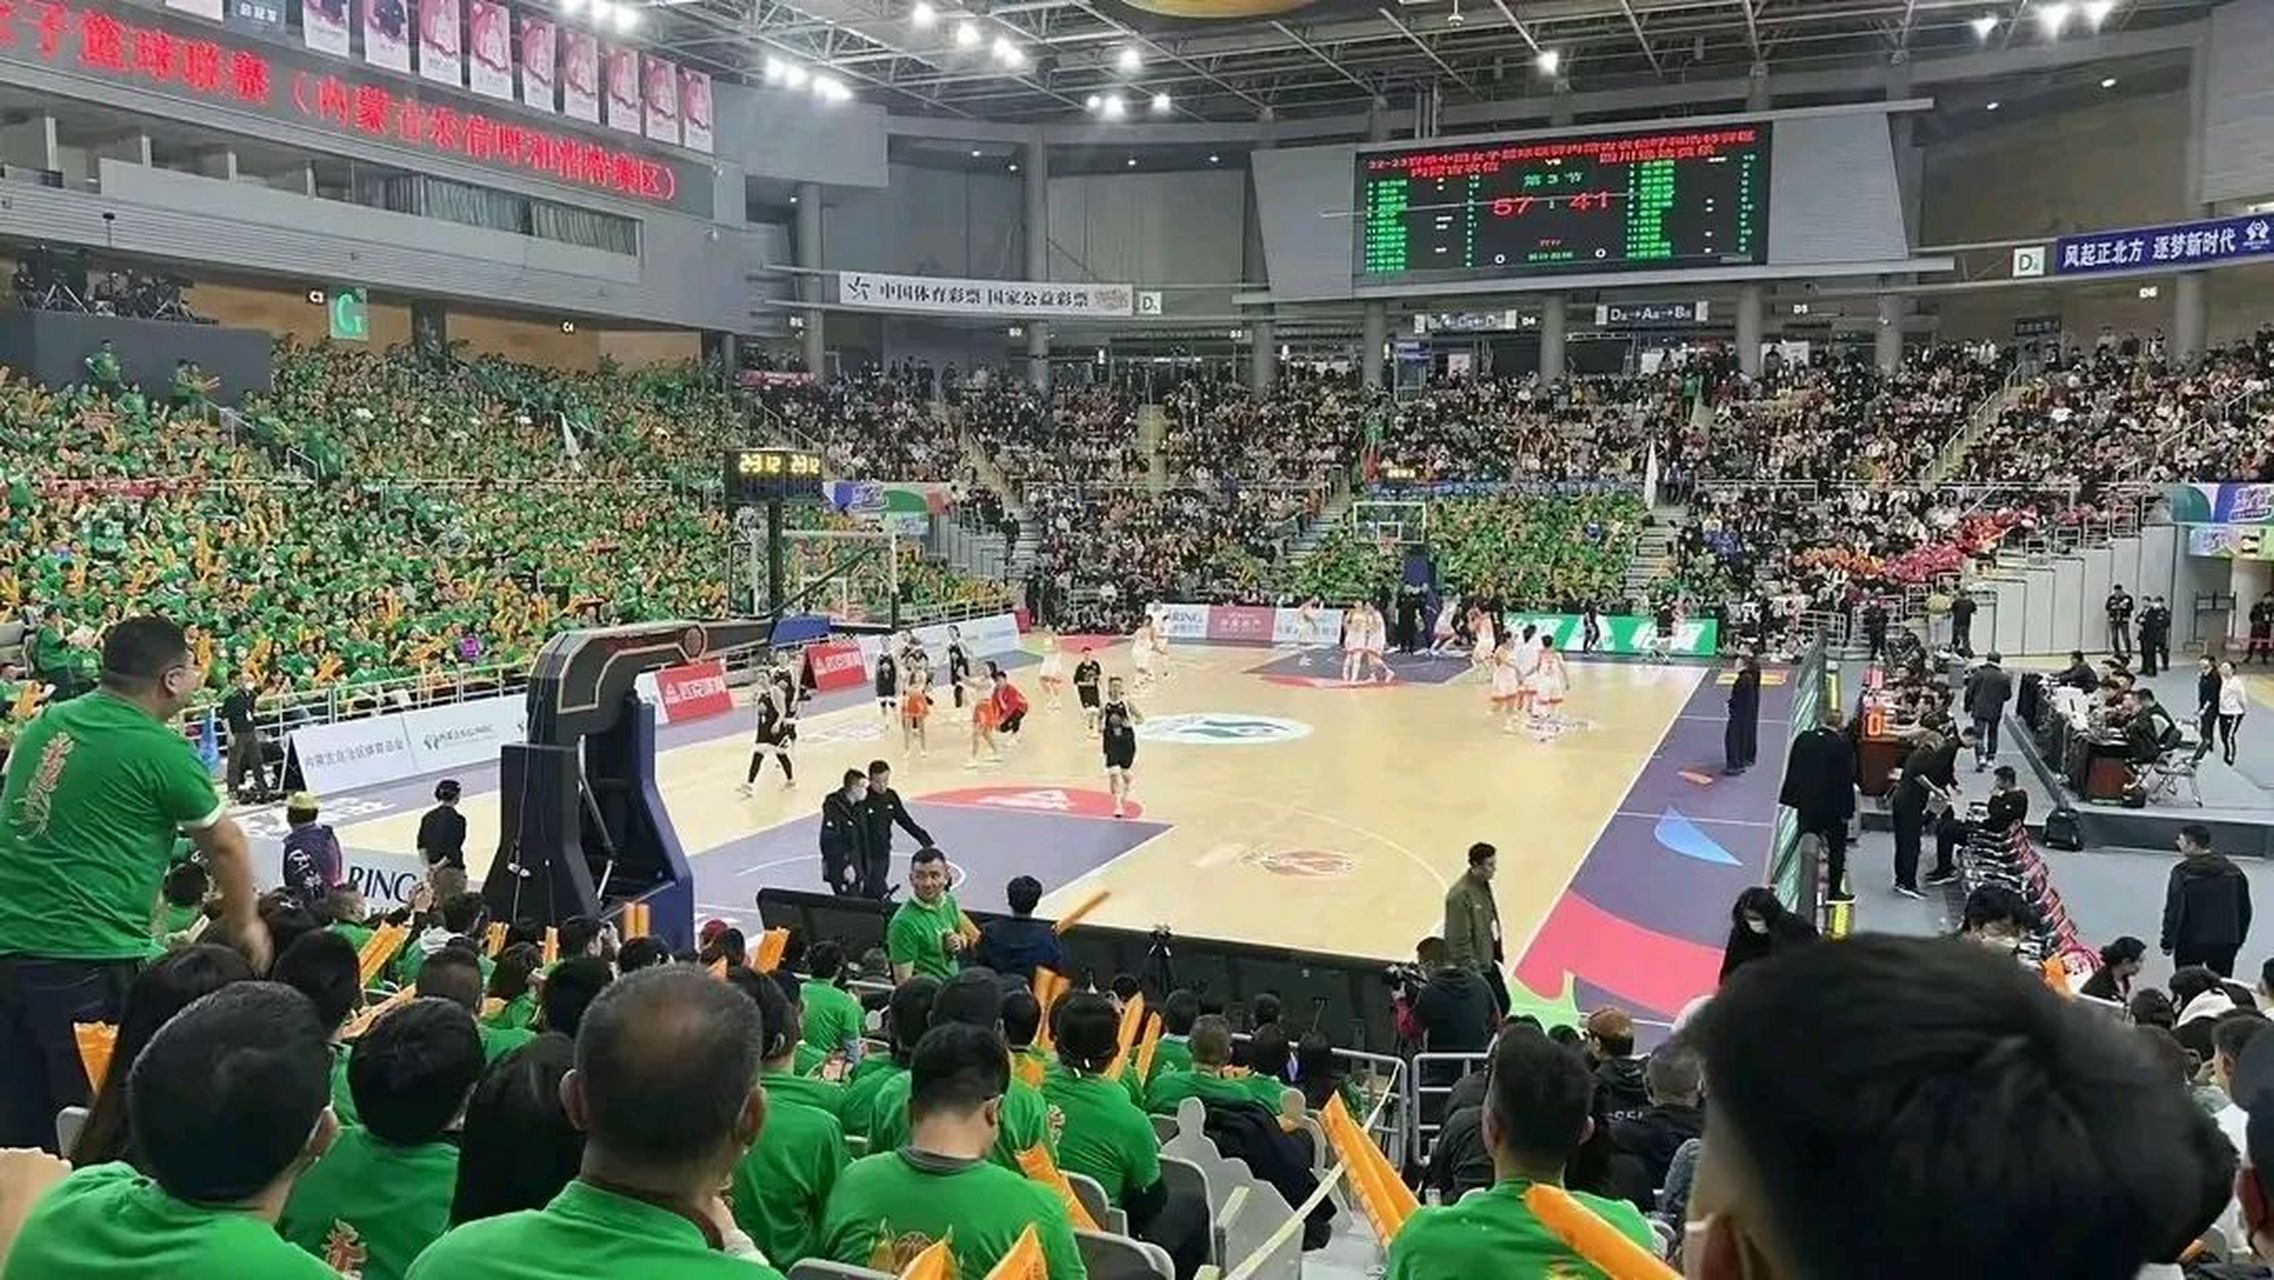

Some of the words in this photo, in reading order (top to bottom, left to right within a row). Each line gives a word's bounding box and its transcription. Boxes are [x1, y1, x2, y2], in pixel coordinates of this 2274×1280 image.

[1493, 197, 1536, 216] 57
[1569, 190, 1611, 210] 41
[2063, 238, 2144, 267] 风起正北方
[2153, 227, 2237, 261] 逐梦新时代
[880, 282, 981, 305] 中国体育彩票
[988, 287, 1089, 307] 国家公益彩票
